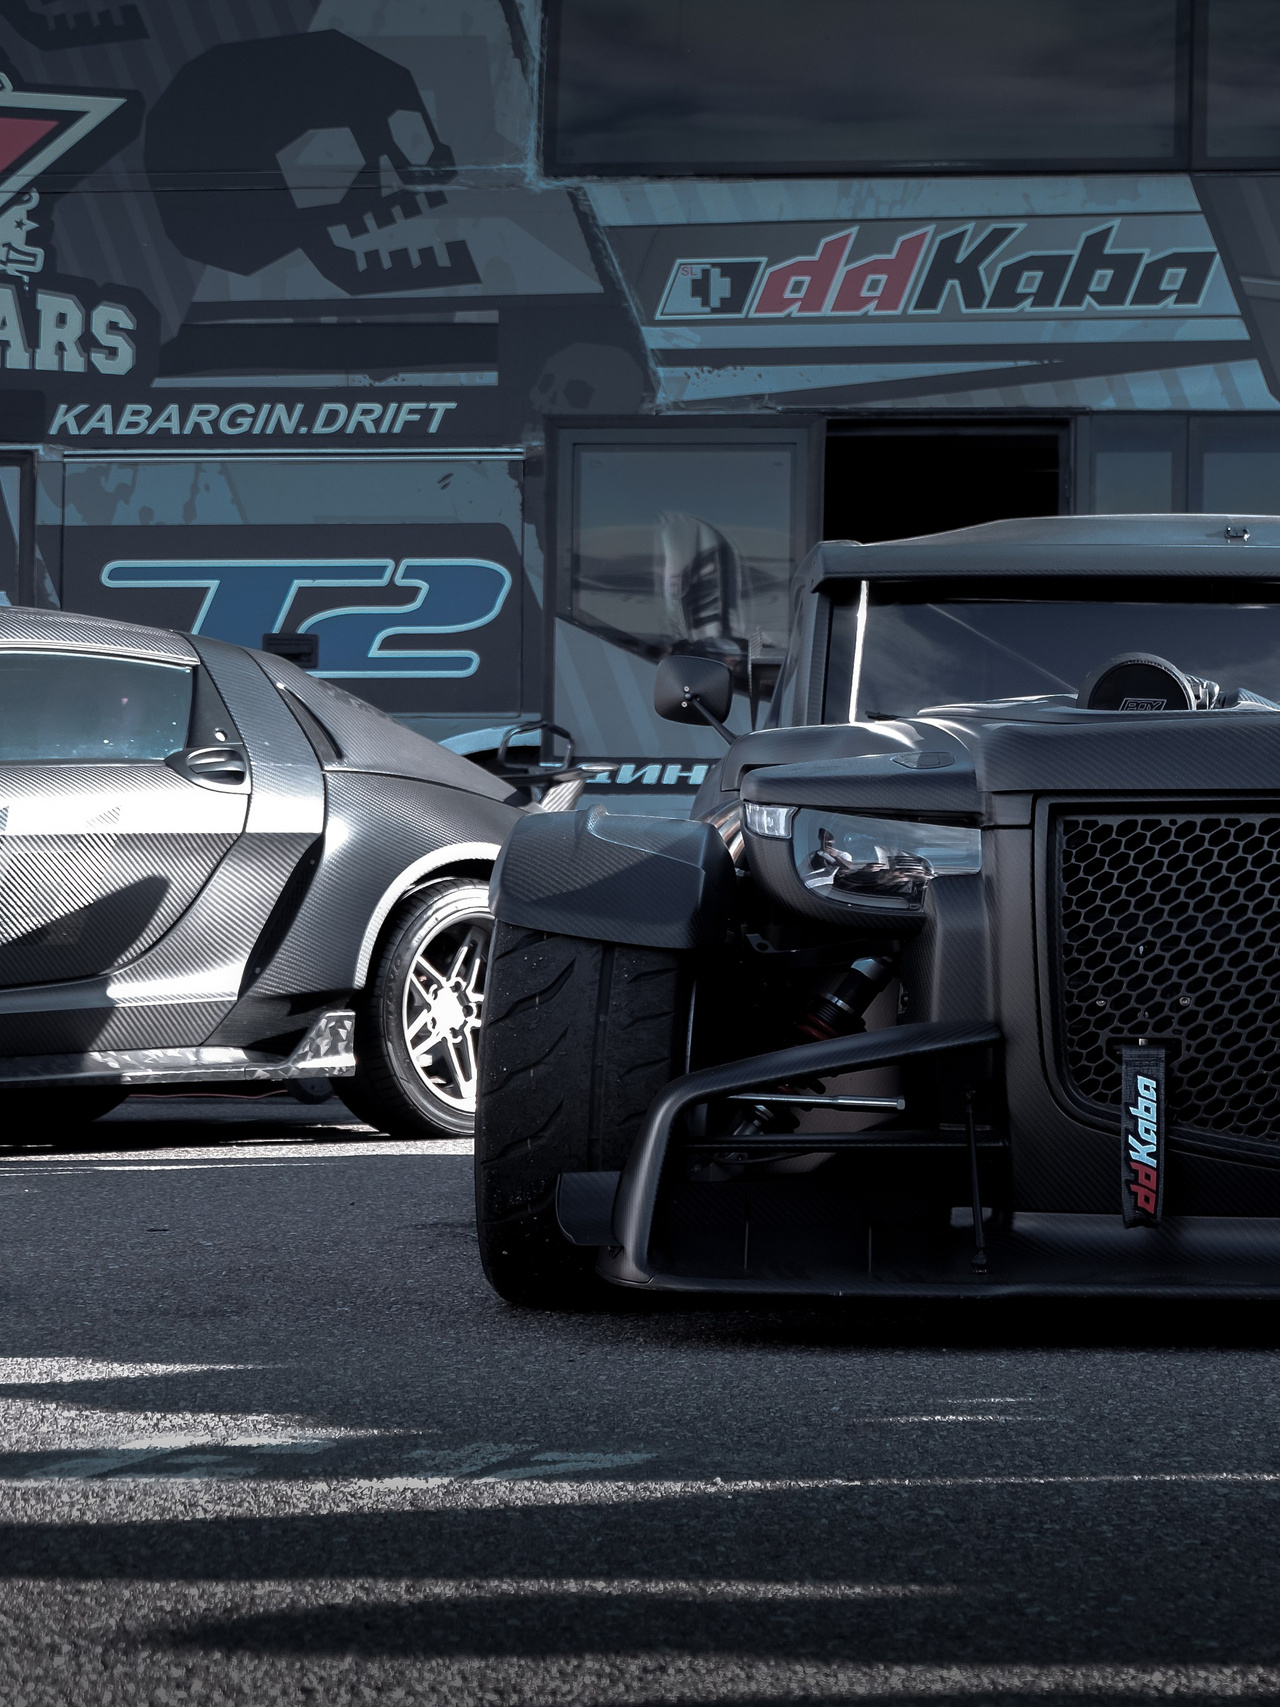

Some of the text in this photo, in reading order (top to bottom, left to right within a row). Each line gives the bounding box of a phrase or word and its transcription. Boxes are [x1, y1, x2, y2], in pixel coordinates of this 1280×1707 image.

[747, 219, 1219, 317] ddKaba
[49, 402, 457, 435] KABARGIN.DRIFT
[101, 558, 512, 678] T2
[1128, 1075, 1158, 1214] ddKaba
